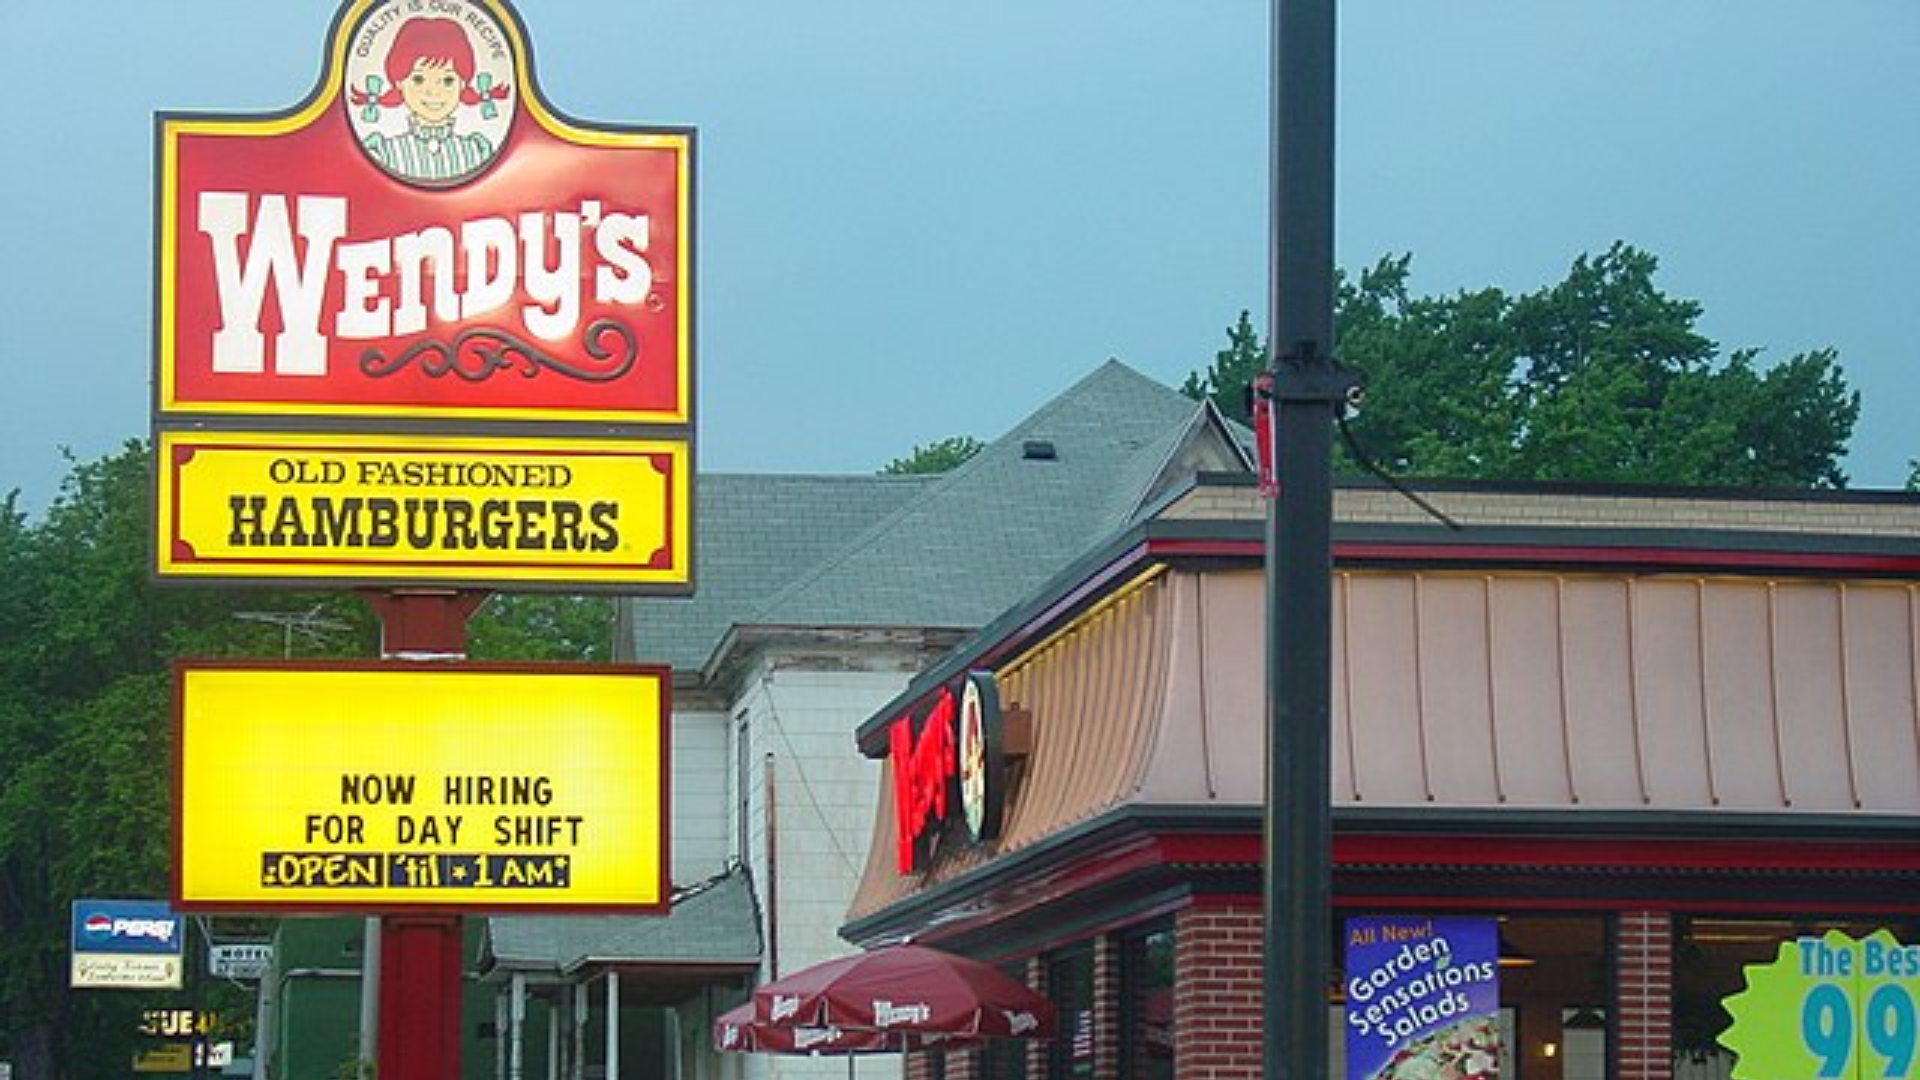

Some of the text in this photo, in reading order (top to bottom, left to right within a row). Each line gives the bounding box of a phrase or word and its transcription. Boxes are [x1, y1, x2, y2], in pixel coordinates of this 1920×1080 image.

[357, 0, 508, 59] QUALITY IS OUR RECIPE
[269, 459, 573, 489] OLD FASHIONED
[228, 495, 620, 553] HAMBURGERS
[341, 775, 553, 805] NOW HIRING
[305, 815, 584, 846] FOR DAY SHIFT
[278, 854, 377, 886] OPEN
[1351, 920, 1434, 945] All New!
[1349, 937, 1450, 1001] Garden
[1799, 940, 1920, 976] The Bes
[1349, 961, 1496, 1036] Sensations
[1377, 990, 1470, 1047] Salads
[1802, 983, 1917, 1078] 99
